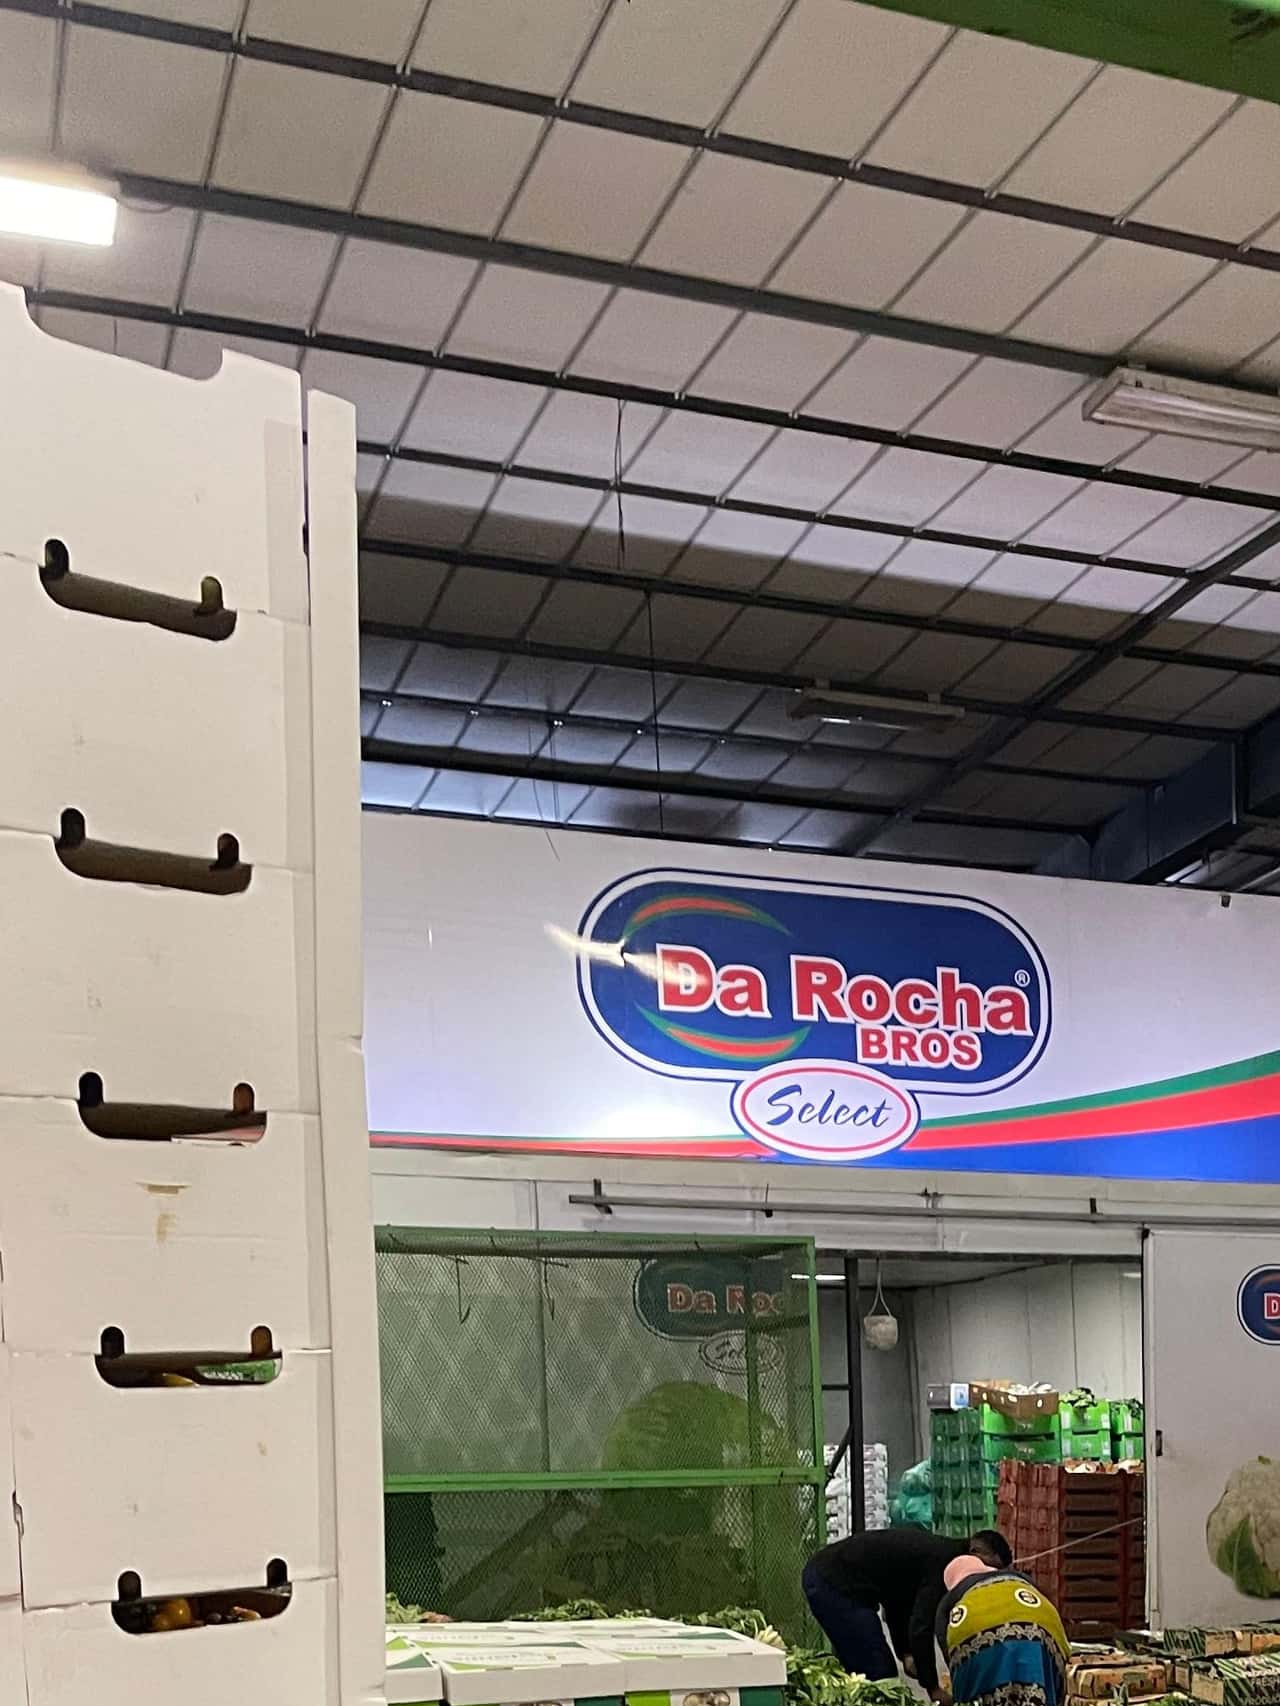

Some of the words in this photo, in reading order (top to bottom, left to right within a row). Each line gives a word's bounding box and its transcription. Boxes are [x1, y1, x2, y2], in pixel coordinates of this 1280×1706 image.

[656, 943, 772, 1018] Da
[790, 954, 1033, 1037] Rocha
[857, 1024, 982, 1070] BROS
[766, 1085, 893, 1130] Select
[667, 1283, 716, 1313] Da
